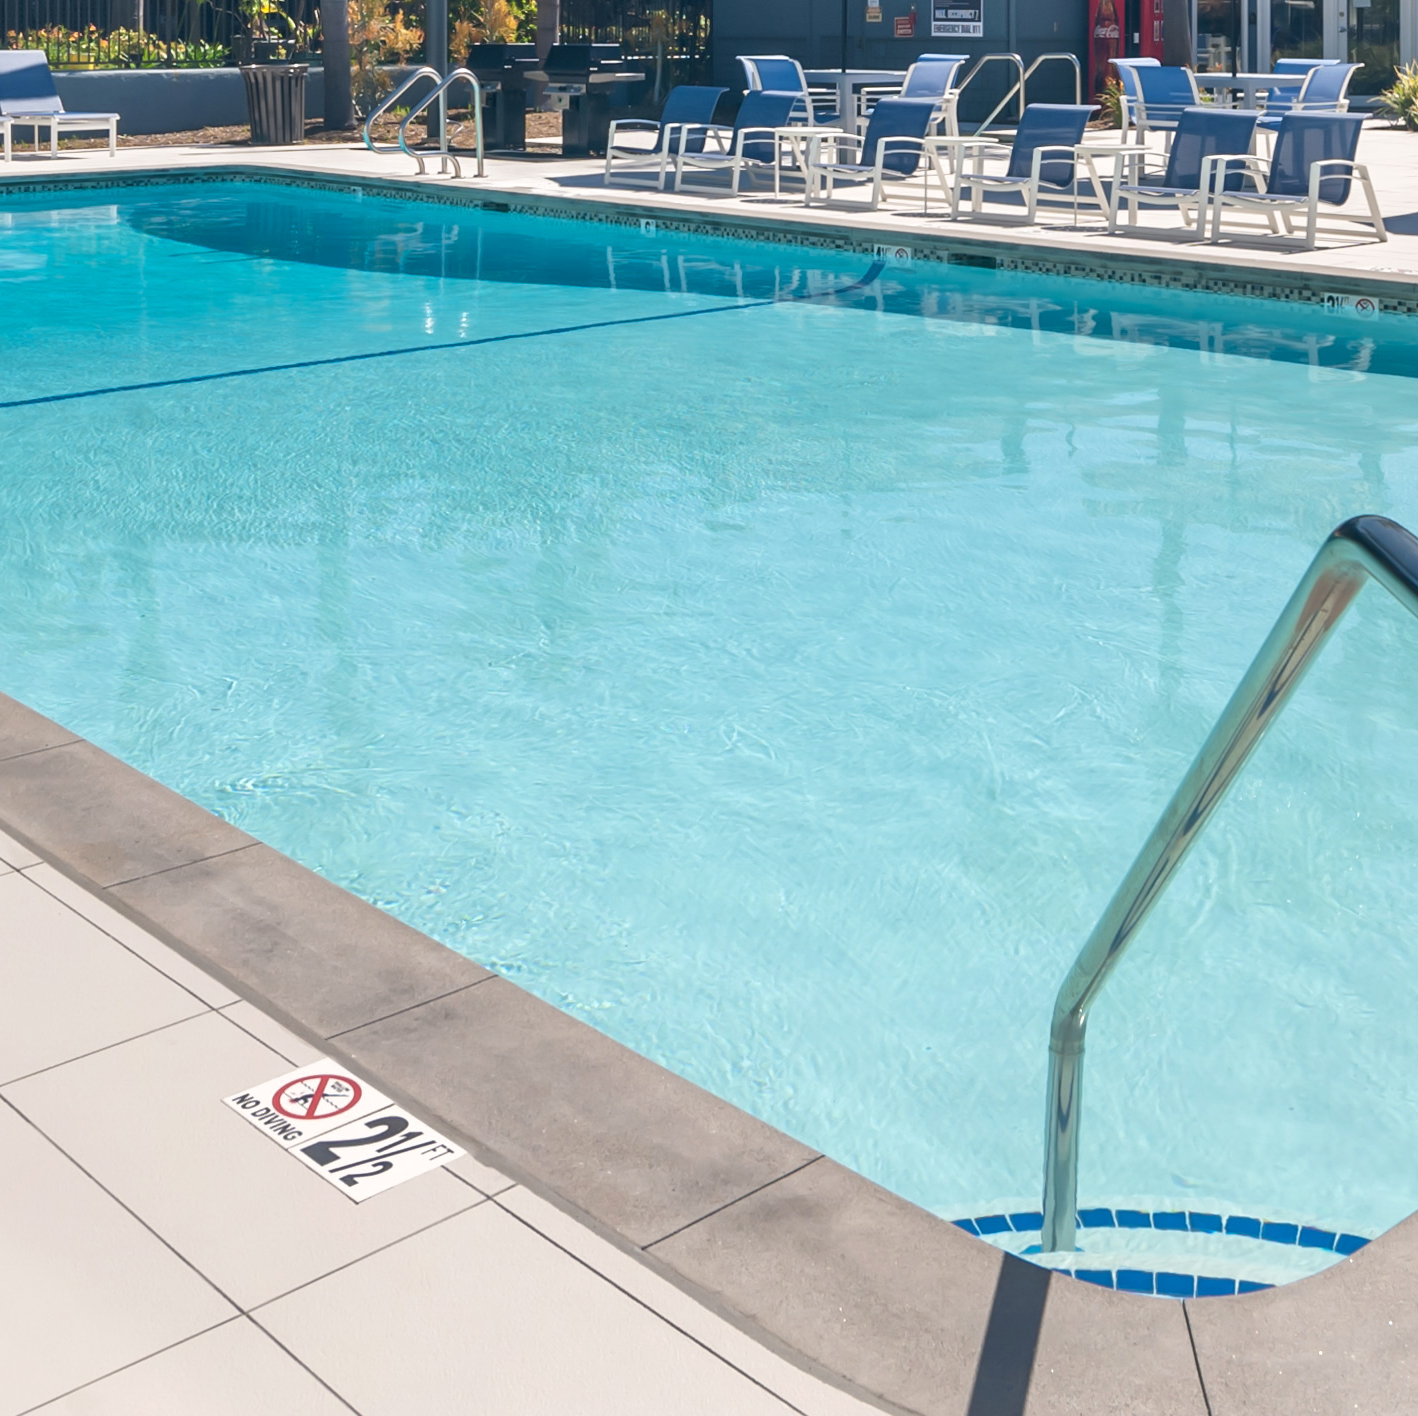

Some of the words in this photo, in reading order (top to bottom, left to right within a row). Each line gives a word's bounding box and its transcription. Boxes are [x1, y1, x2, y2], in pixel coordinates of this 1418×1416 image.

[232, 1093, 254, 1112] NO
[251, 1104, 303, 1142] DIVING
[421, 1144, 454, 1161] FT
